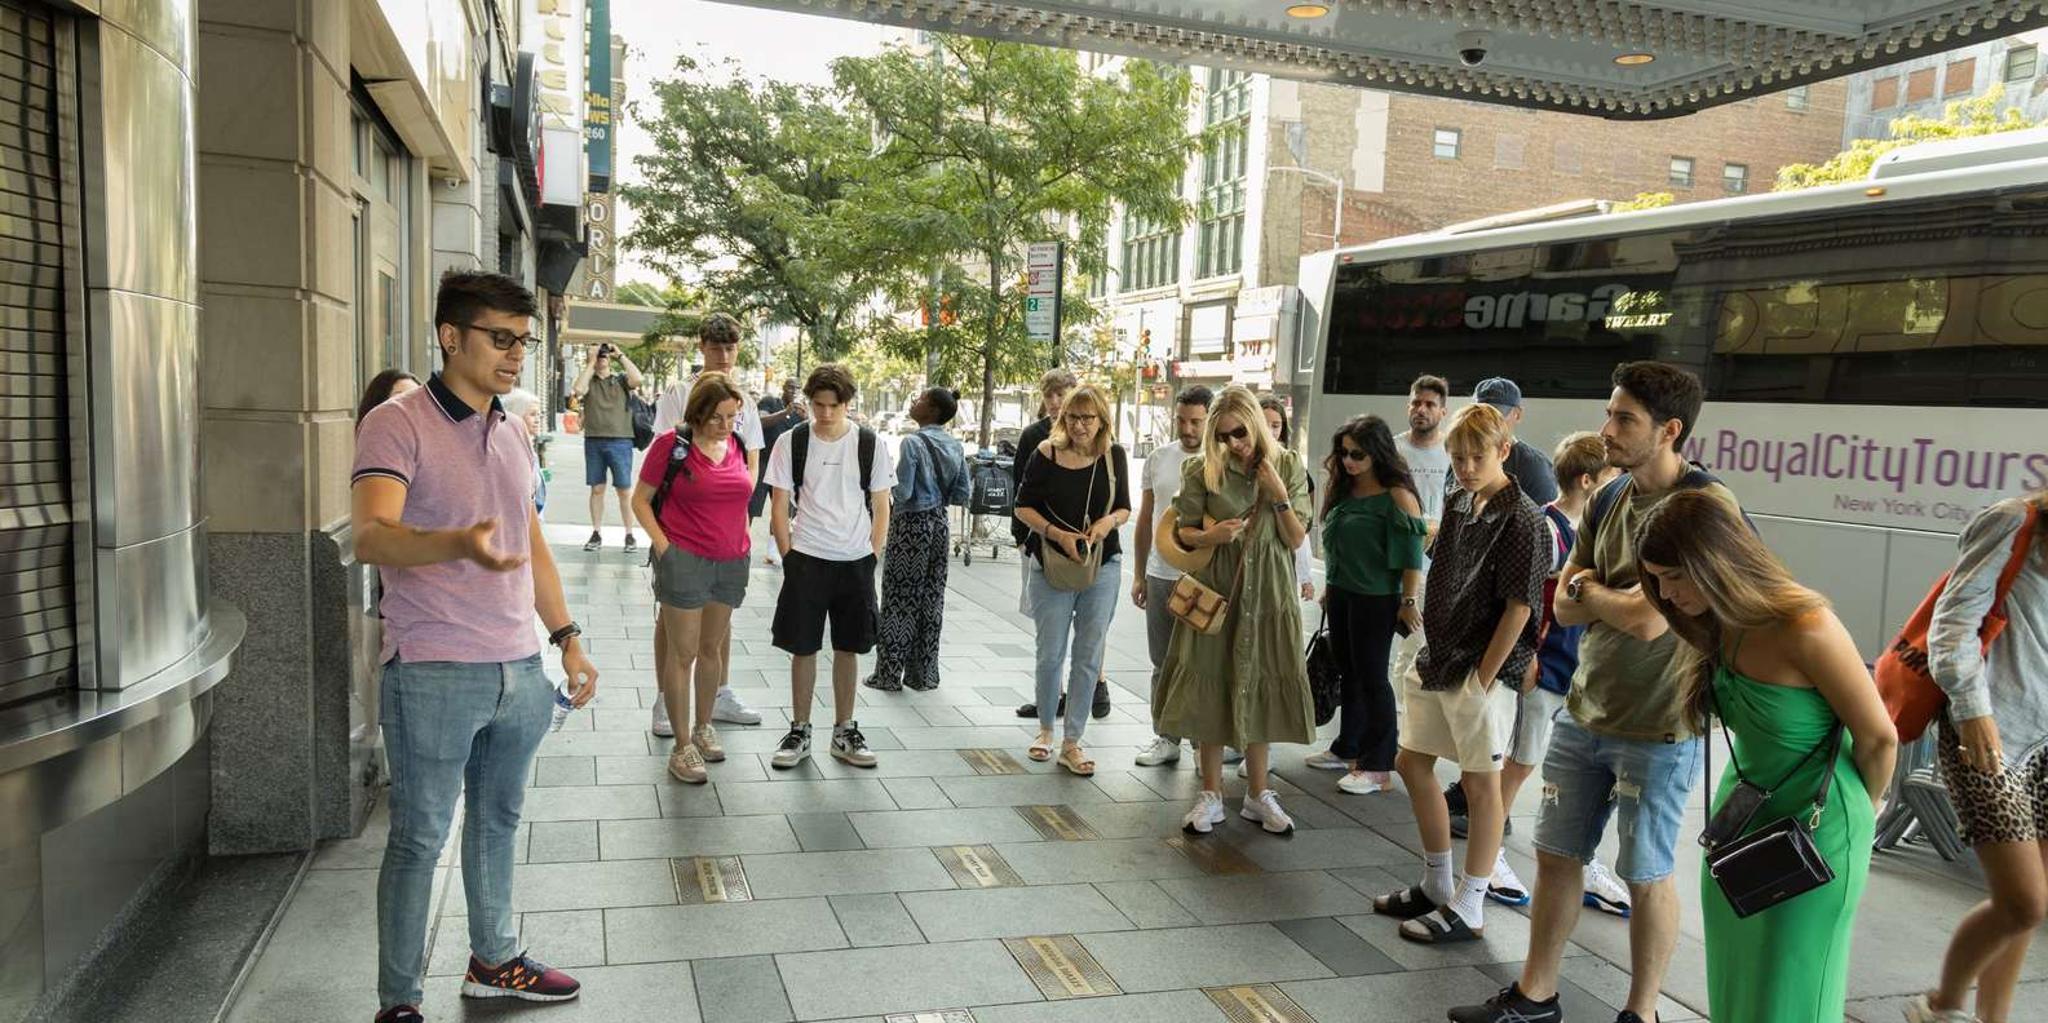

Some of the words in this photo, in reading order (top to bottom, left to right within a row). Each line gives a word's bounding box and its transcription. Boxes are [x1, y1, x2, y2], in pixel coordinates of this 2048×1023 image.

[590, 200, 606, 299] ORIA
[1684, 430, 2048, 492] w.RoyalCityTours
[1833, 493, 1875, 513] New
[1881, 497, 1926, 516] York
[1931, 501, 1975, 525] City
